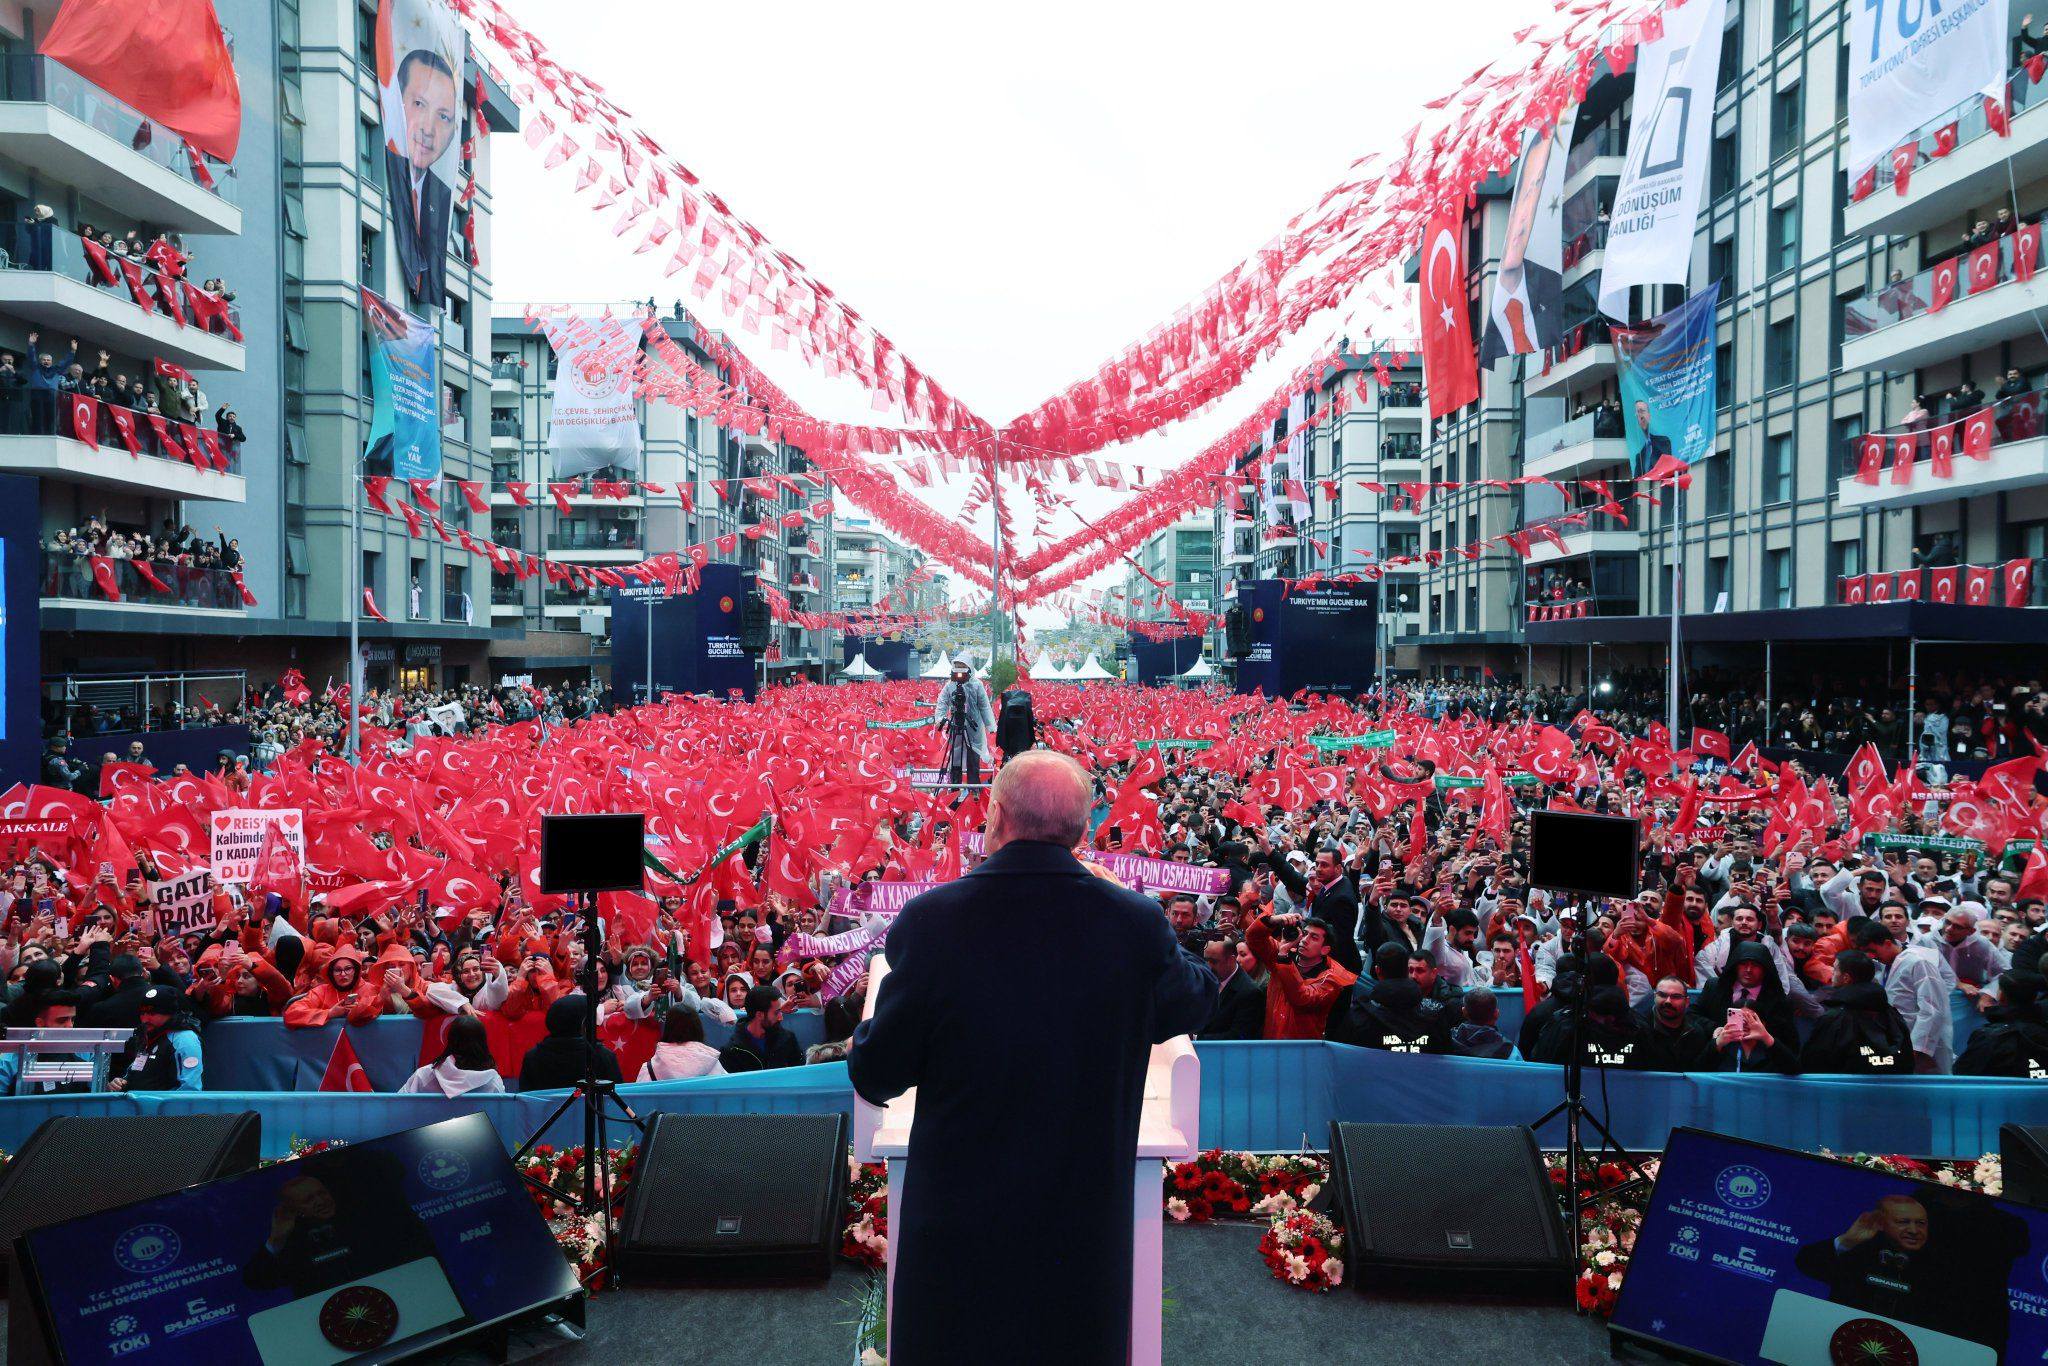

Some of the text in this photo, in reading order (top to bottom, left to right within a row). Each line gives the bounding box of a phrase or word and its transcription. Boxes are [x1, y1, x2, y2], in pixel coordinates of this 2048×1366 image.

[1355, 599, 1367, 607] BAK
[1113, 856, 1126, 878] AK
[1129, 858, 1160, 885] KADIN
[1162, 864, 1214, 892] OSMANİYE
[871, 884, 886, 910] AK
[827, 965, 845, 992] AK
[460, 1223, 492, 1243] AFAD
[1668, 1203, 1693, 1217] İKLİM
[1748, 1225, 1799, 1245] BAKANLIĞI
[1780, 1224, 1792, 1234] VE
[210, 1257, 223, 1268] VE
[181, 1264, 237, 1286] BAKANLIĞI
